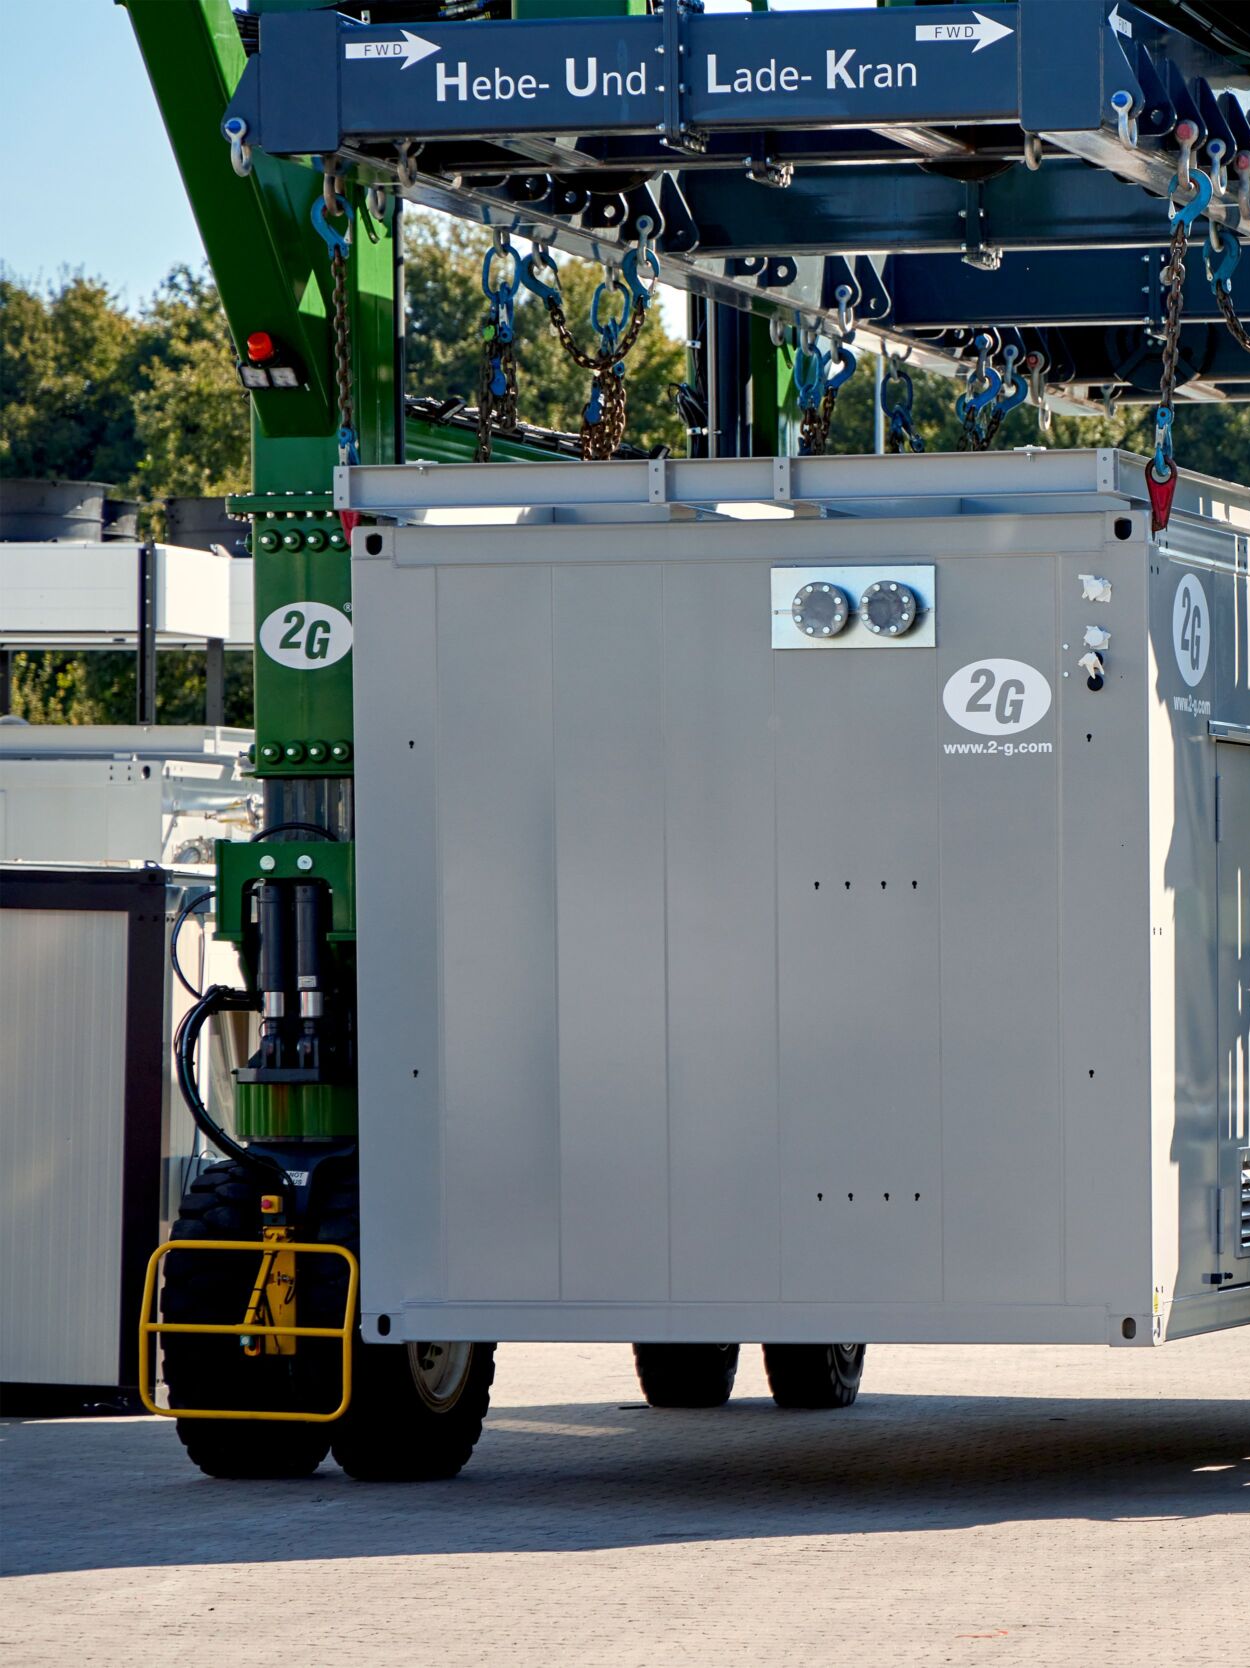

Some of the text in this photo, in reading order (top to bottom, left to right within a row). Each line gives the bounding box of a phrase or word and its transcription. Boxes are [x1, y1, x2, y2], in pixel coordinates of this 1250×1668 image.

[363, 43, 403, 56] FWD
[934, 25, 975, 39] FWD
[436, 48, 917, 102] Hebe- Und Lade- Kran
[279, 610, 331, 660] 2G
[1180, 586, 1201, 671] 2G
[965, 668, 1025, 725] 2G
[1173, 694, 1211, 717] www.2-g.com
[943, 740, 1053, 756] www.2-g.com
